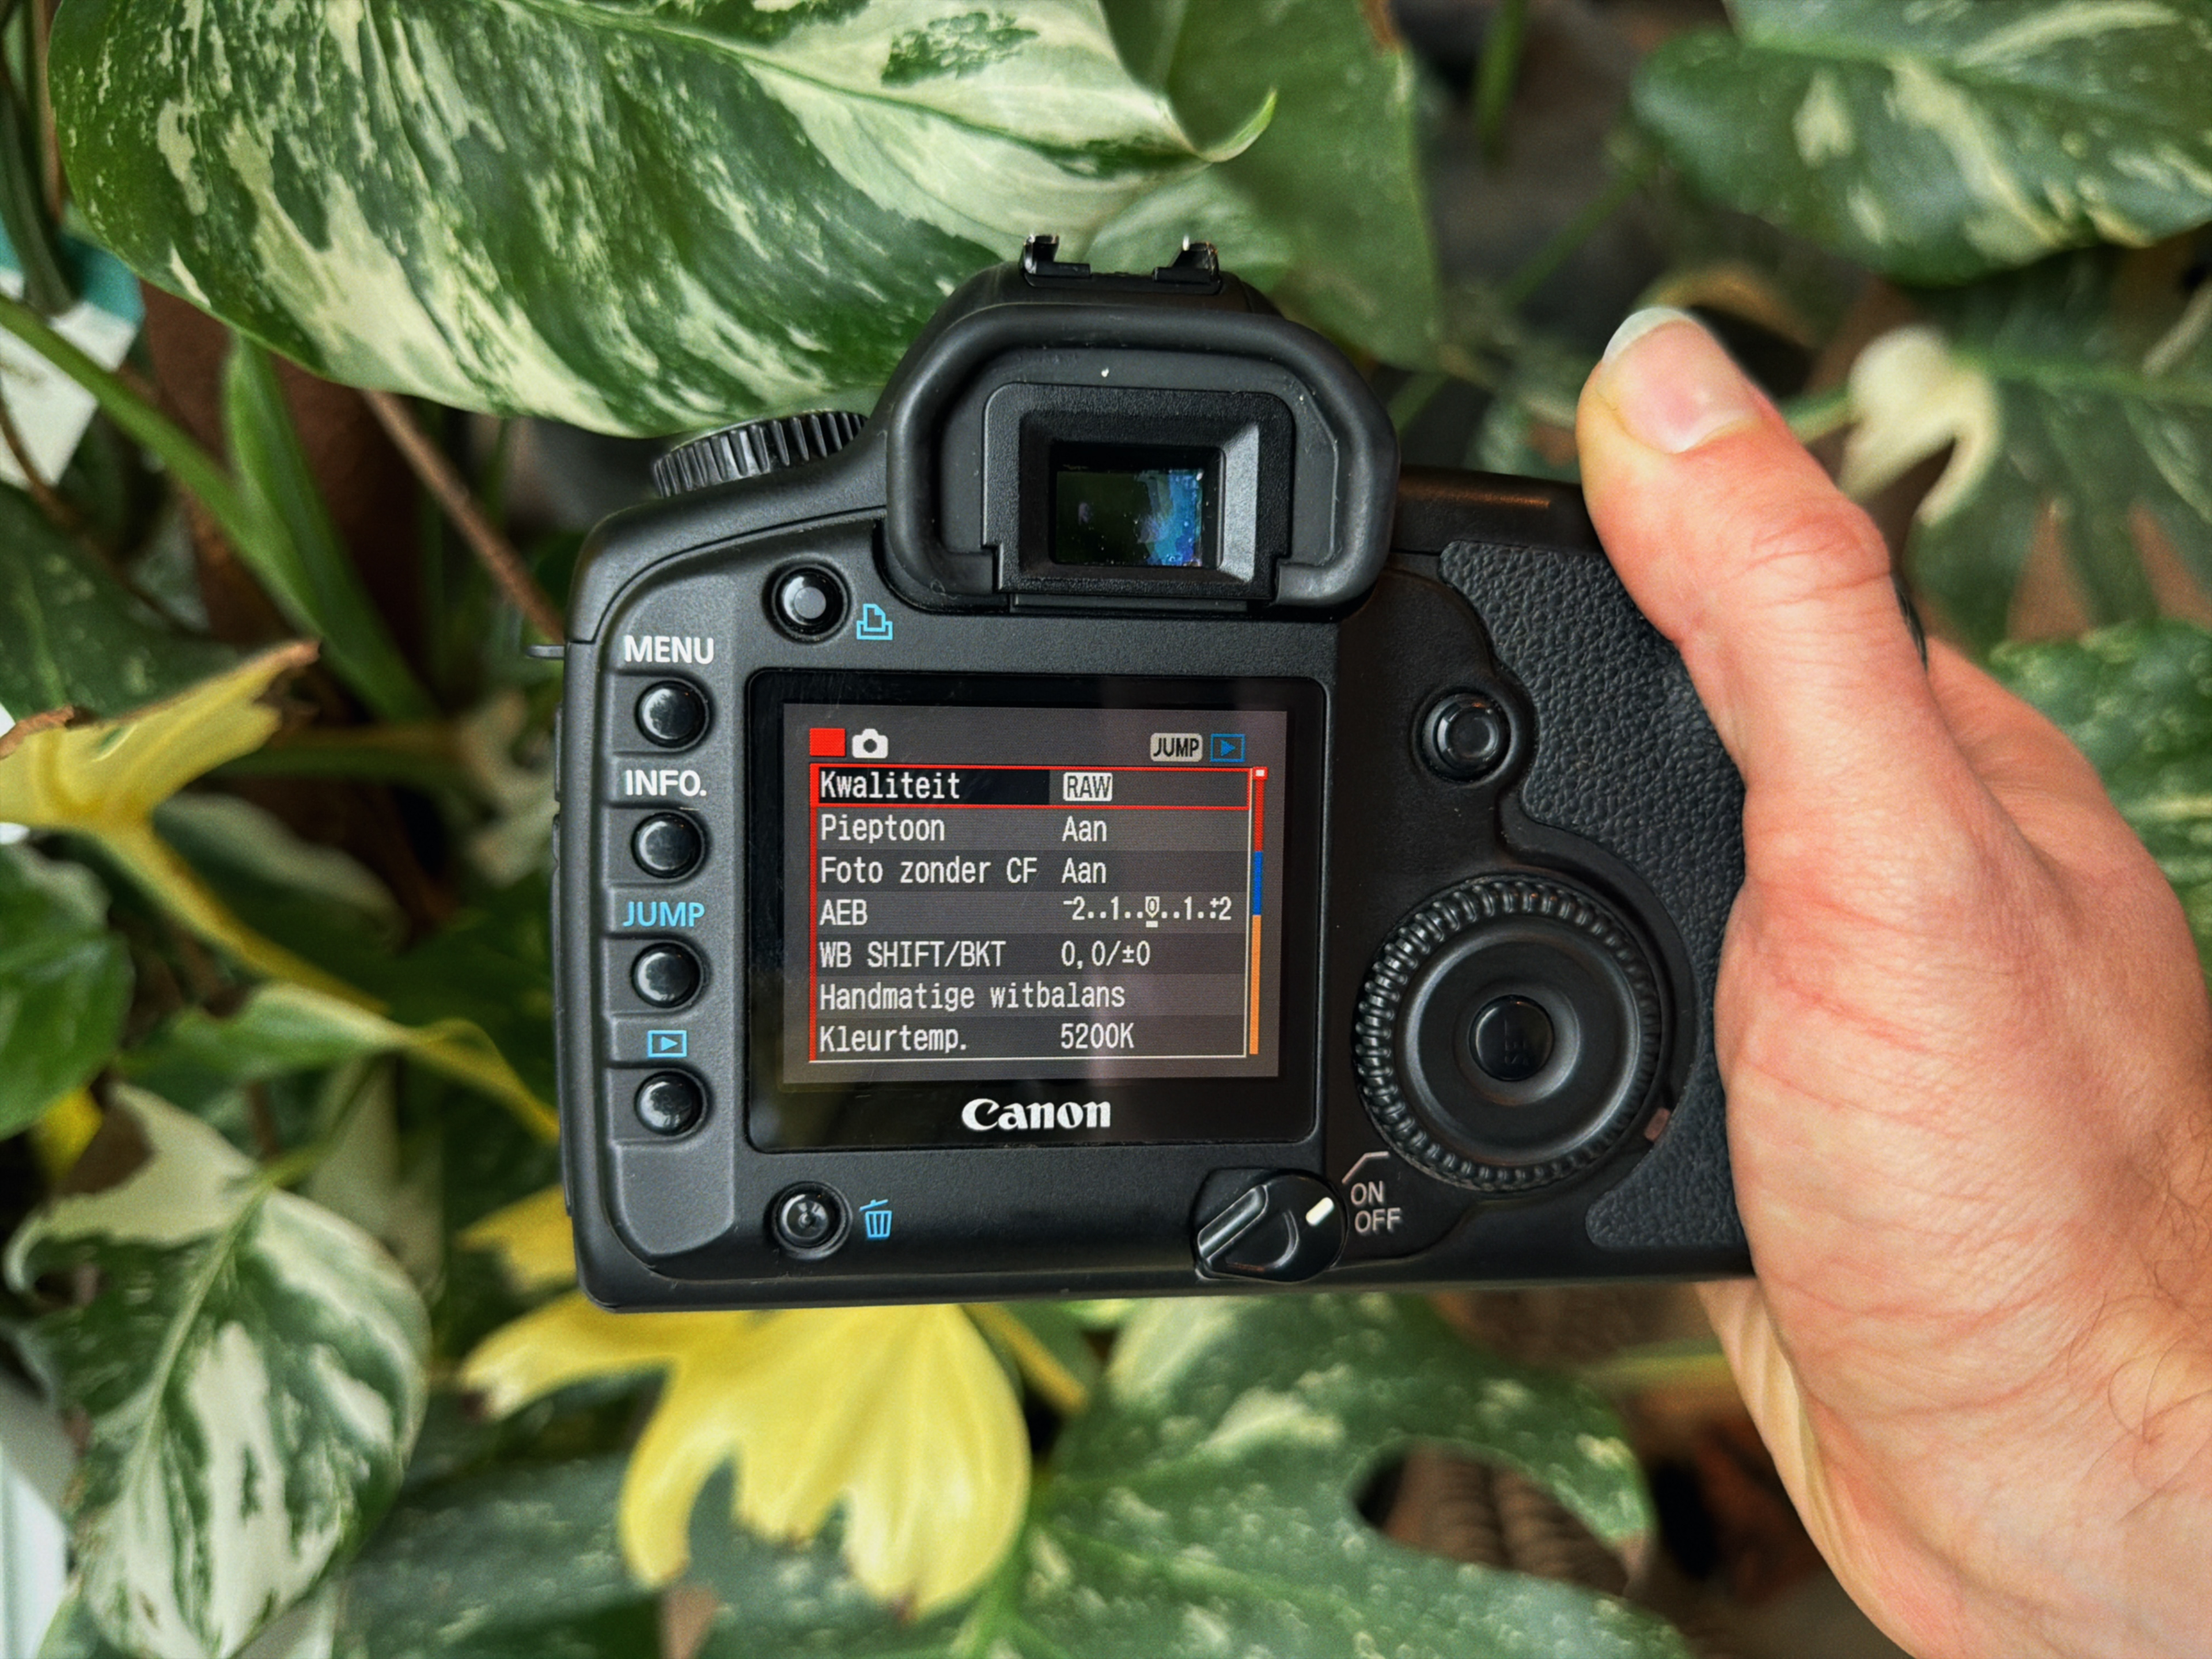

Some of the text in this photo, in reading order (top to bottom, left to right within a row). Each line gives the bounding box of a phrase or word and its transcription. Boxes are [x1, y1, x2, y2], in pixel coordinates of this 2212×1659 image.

[623, 635, 714, 664] MENU
[1154, 738, 1200, 756] JUMP
[625, 770, 706, 796] INFO.
[821, 771, 1109, 798] Kwaliteit RAW
[822, 814, 1107, 843] Pieptoon Aan
[822, 856, 1105, 883] Foto zonder CF Aan
[623, 902, 704, 927] JUMP
[820, 899, 867, 925] AEB
[820, 942, 851, 967] WB
[868, 941, 1006, 967] SHIFT/BKT
[821, 981, 1125, 1011] Handmatige witbalans
[820, 1023, 1134, 1053] Kleurtemp. 5200K
[962, 1099, 1110, 1130] Canon
[1351, 1181, 1383, 1205] ON
[1355, 1208, 1400, 1233] OFF
